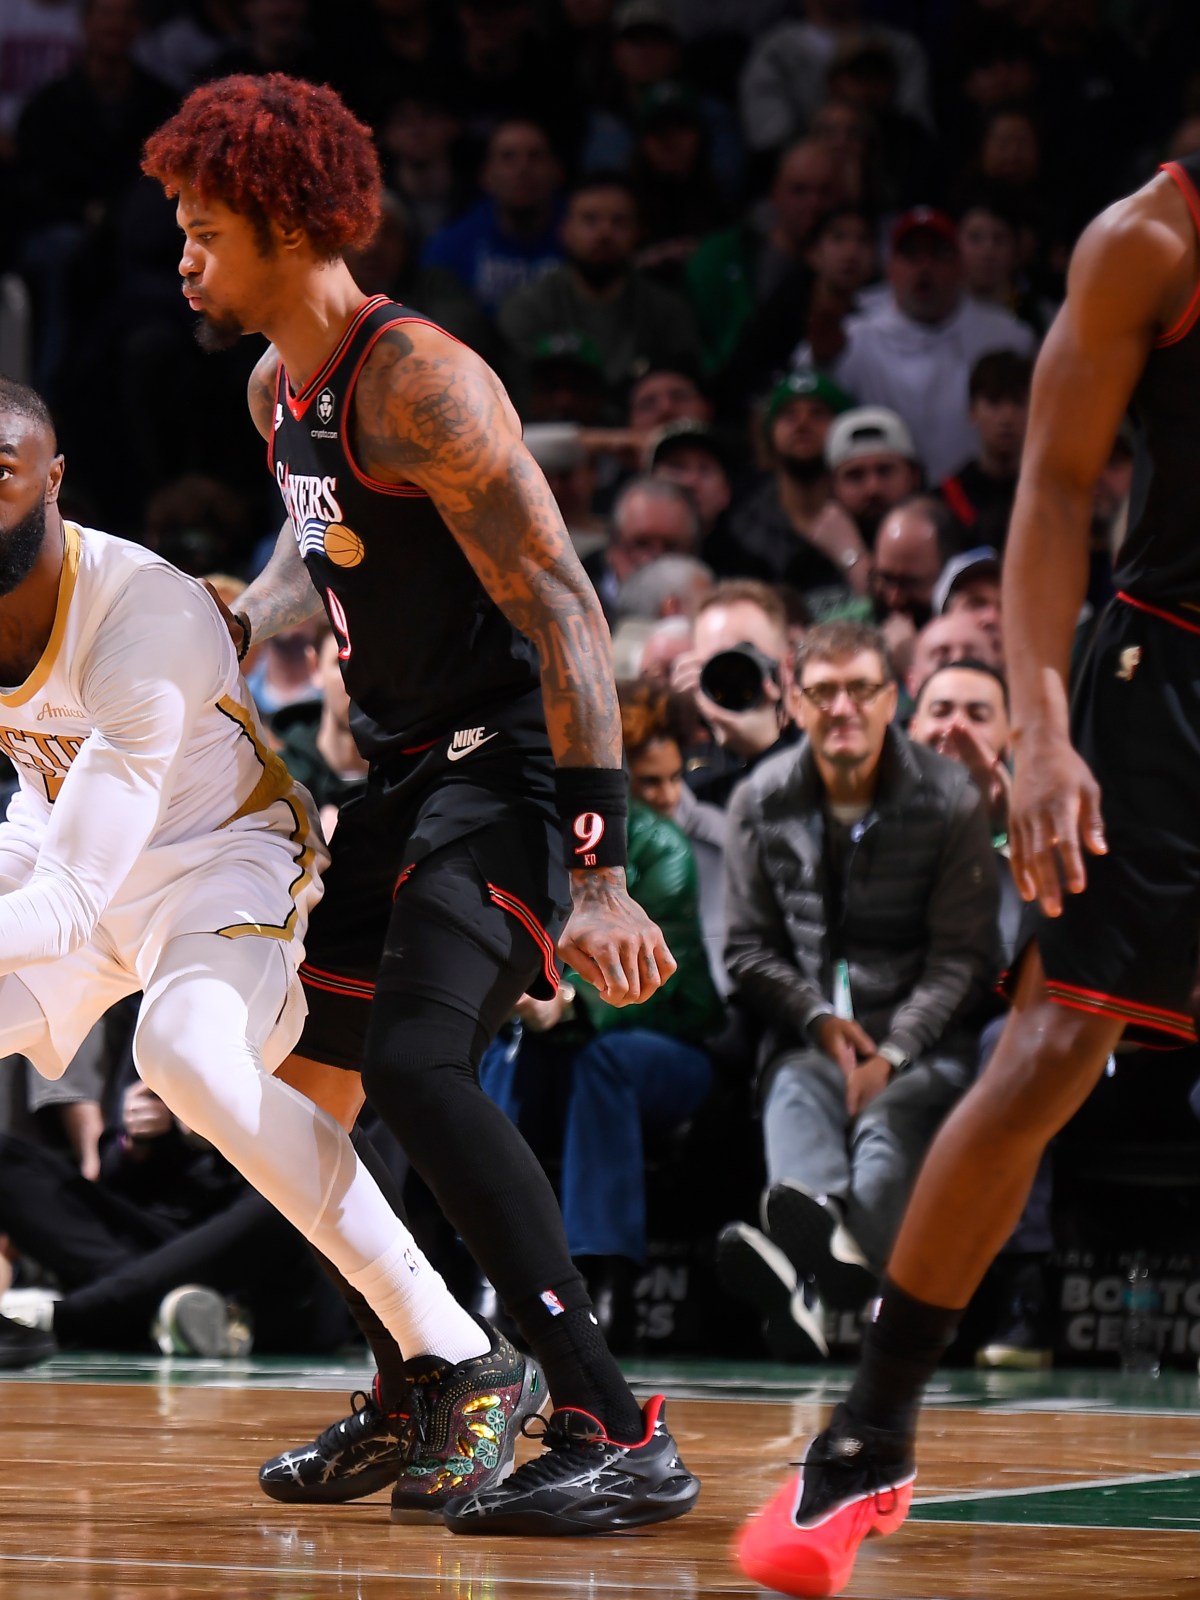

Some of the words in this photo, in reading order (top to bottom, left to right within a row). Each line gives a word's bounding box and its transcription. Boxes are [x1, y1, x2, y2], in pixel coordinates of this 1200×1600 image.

[37, 702, 87, 721] Amica
[452, 726, 486, 749] NIKE
[573, 811, 605, 854] 9
